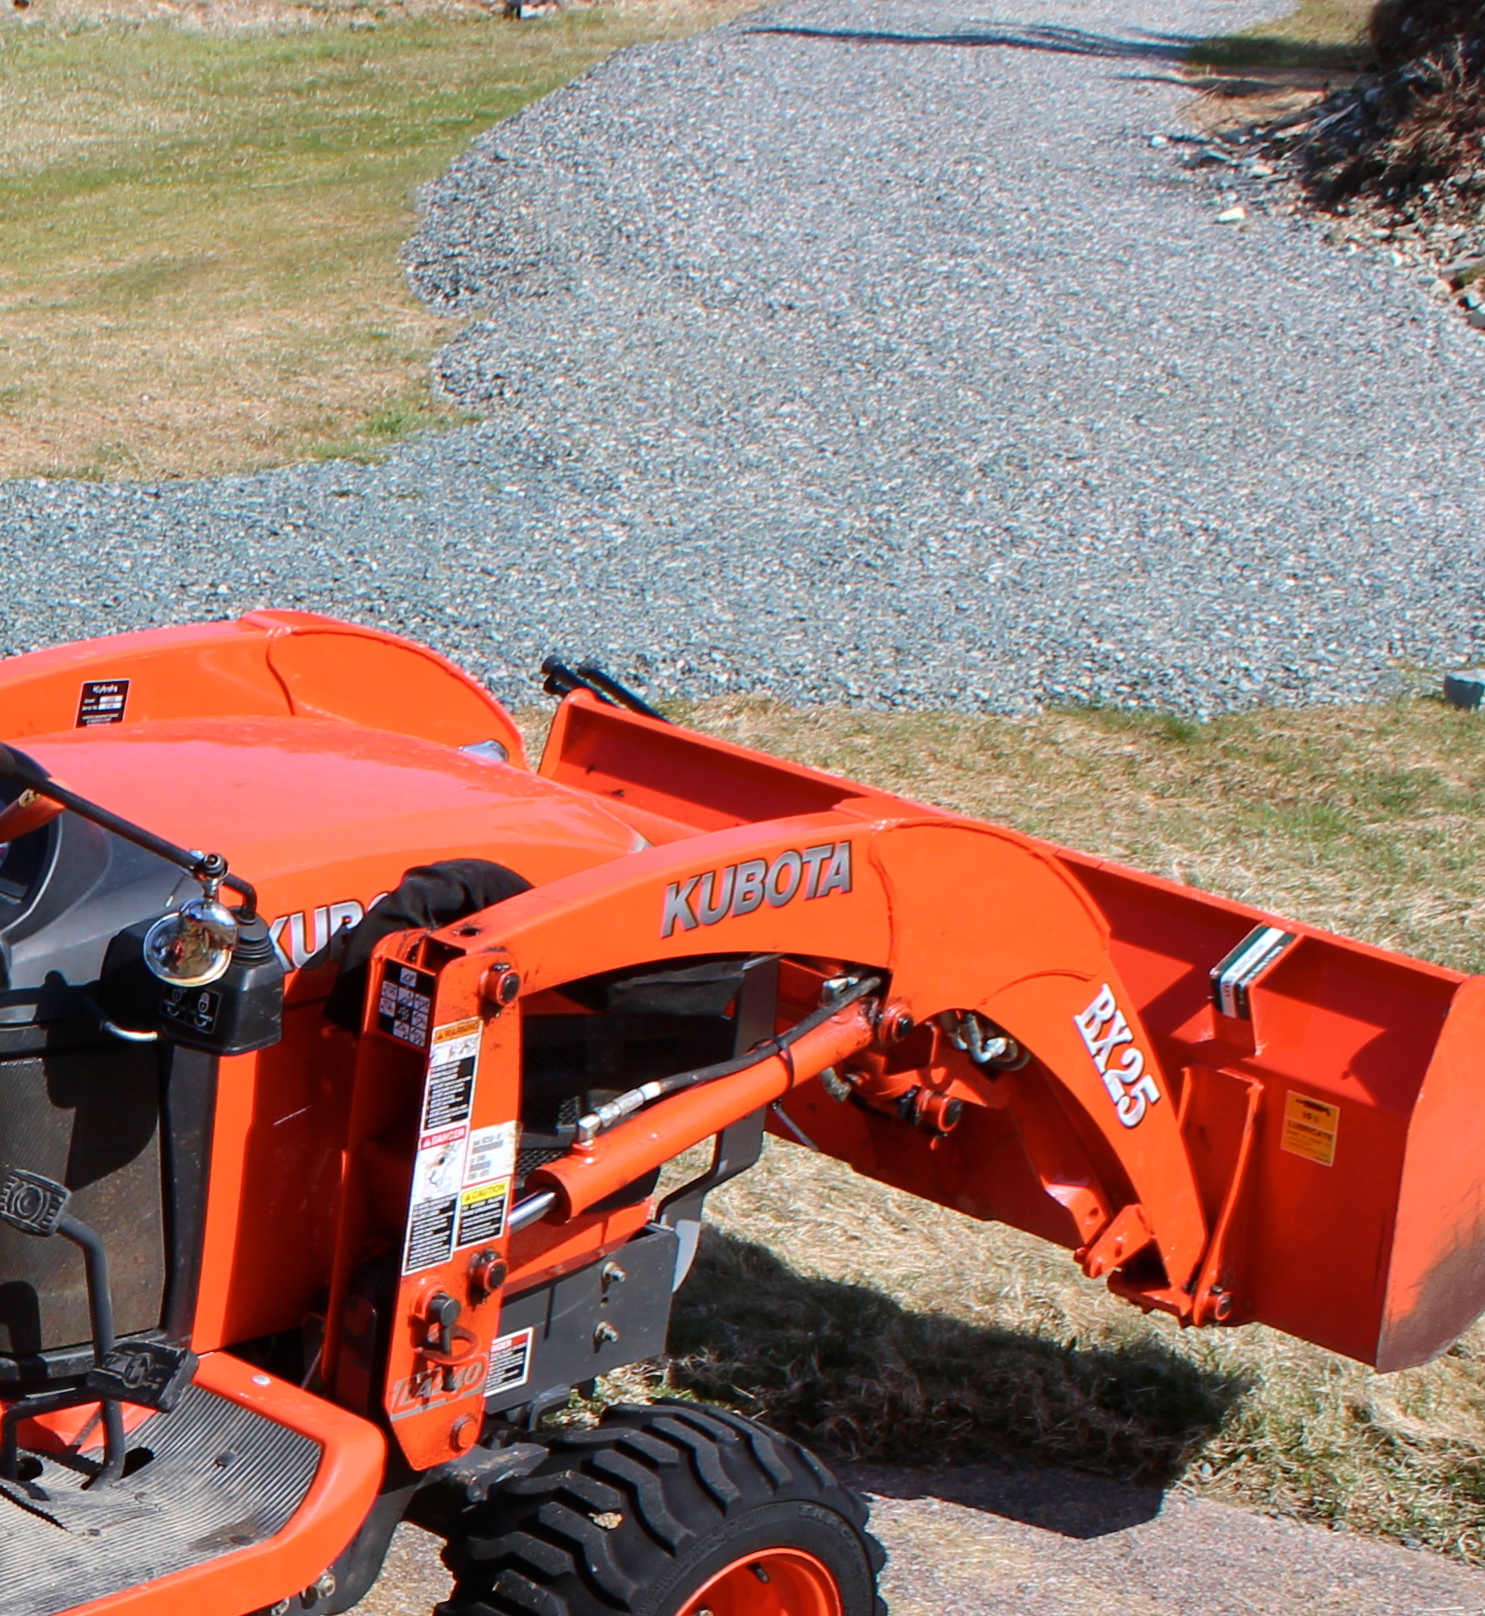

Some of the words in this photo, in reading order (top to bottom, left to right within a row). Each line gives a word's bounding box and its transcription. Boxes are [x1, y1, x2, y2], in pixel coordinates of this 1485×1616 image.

[661, 840, 853, 940] KUBOTA
[1073, 982, 1161, 1129] BX25
[431, 1128, 465, 1145] DANGER
[471, 1183, 506, 1199] CAUTION
